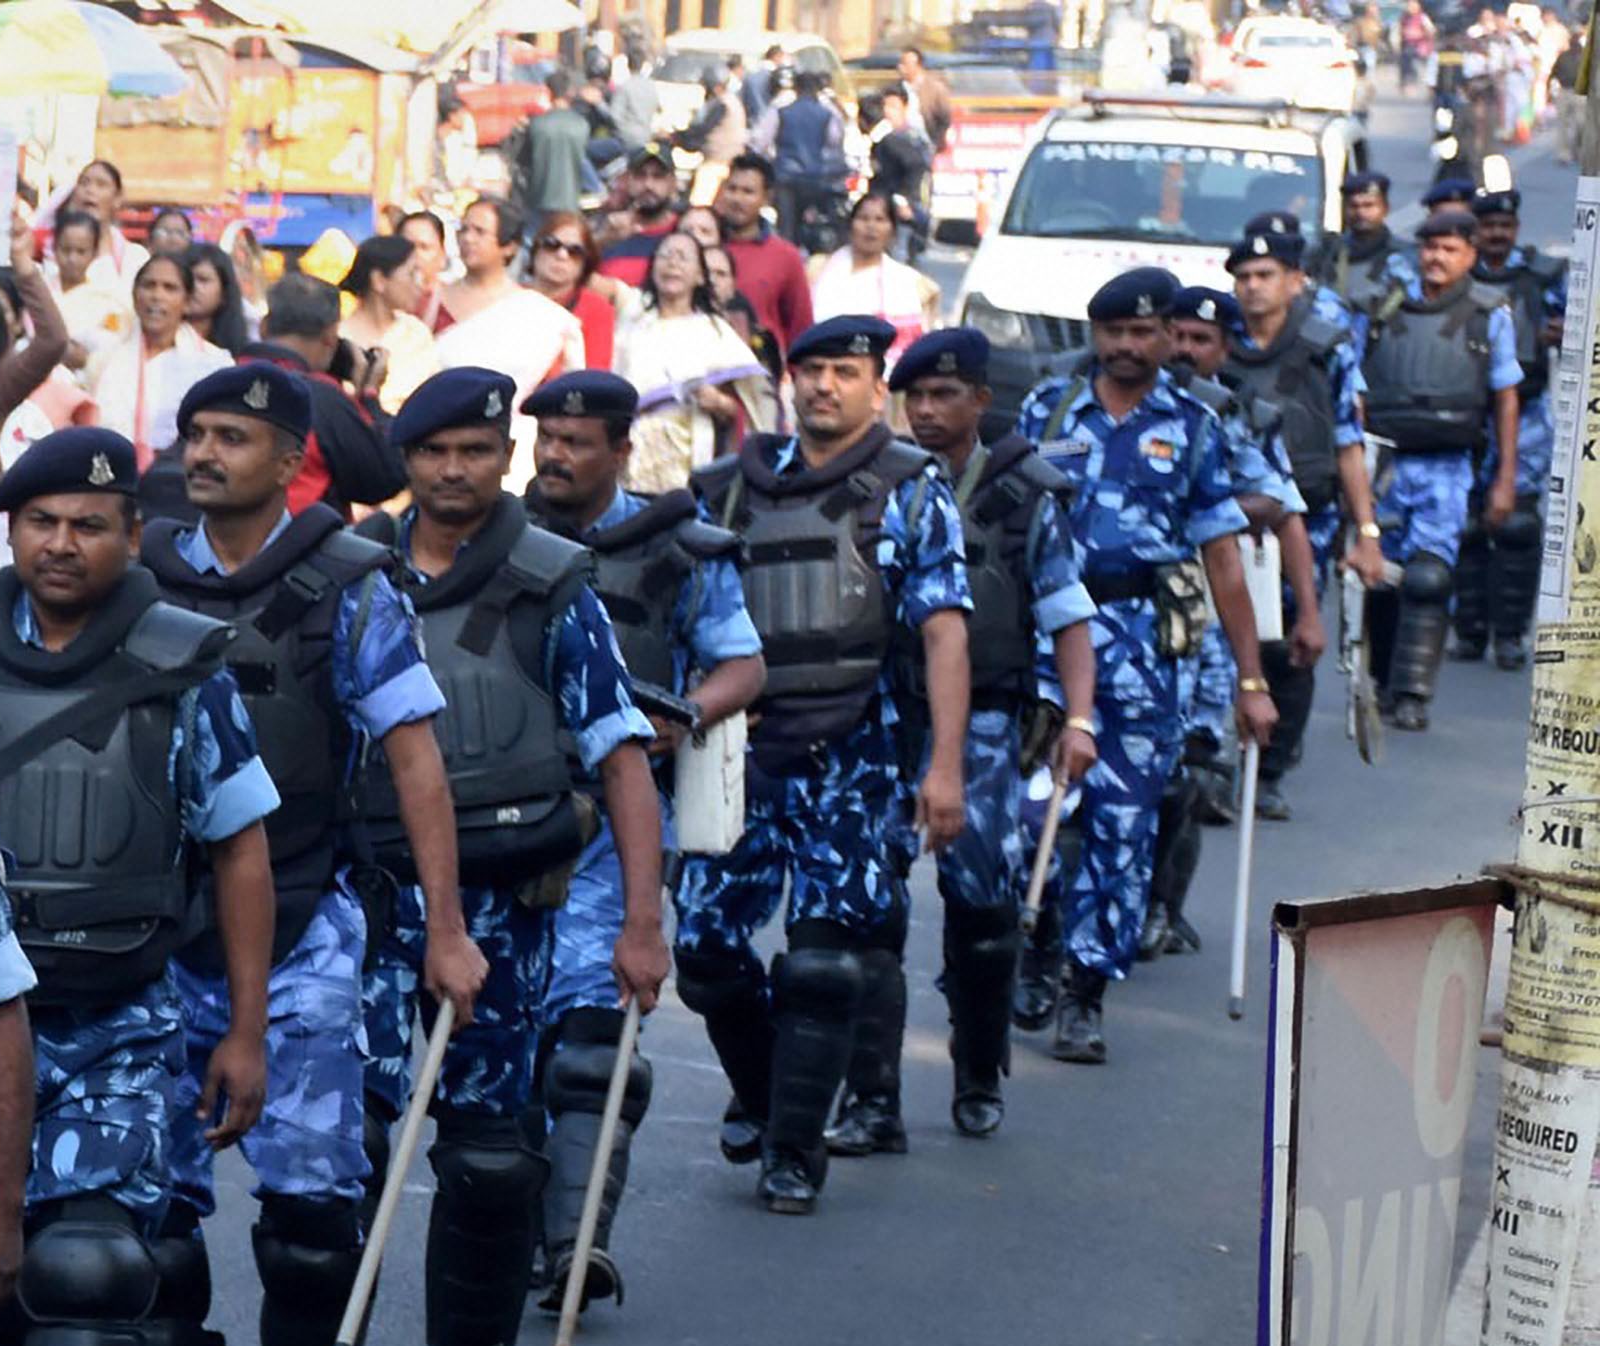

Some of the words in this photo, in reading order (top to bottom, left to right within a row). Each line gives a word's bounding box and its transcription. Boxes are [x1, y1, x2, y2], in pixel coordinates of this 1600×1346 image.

[1547, 780, 1568, 796] X
[1539, 820, 1584, 850] XII
[1502, 1112, 1579, 1154] REQUIRED
[1491, 1206, 1519, 1236] XII
[1508, 1246, 1560, 1271] Chemistry
[1508, 1289, 1549, 1309] Physics
[1506, 1308, 1545, 1328] English
